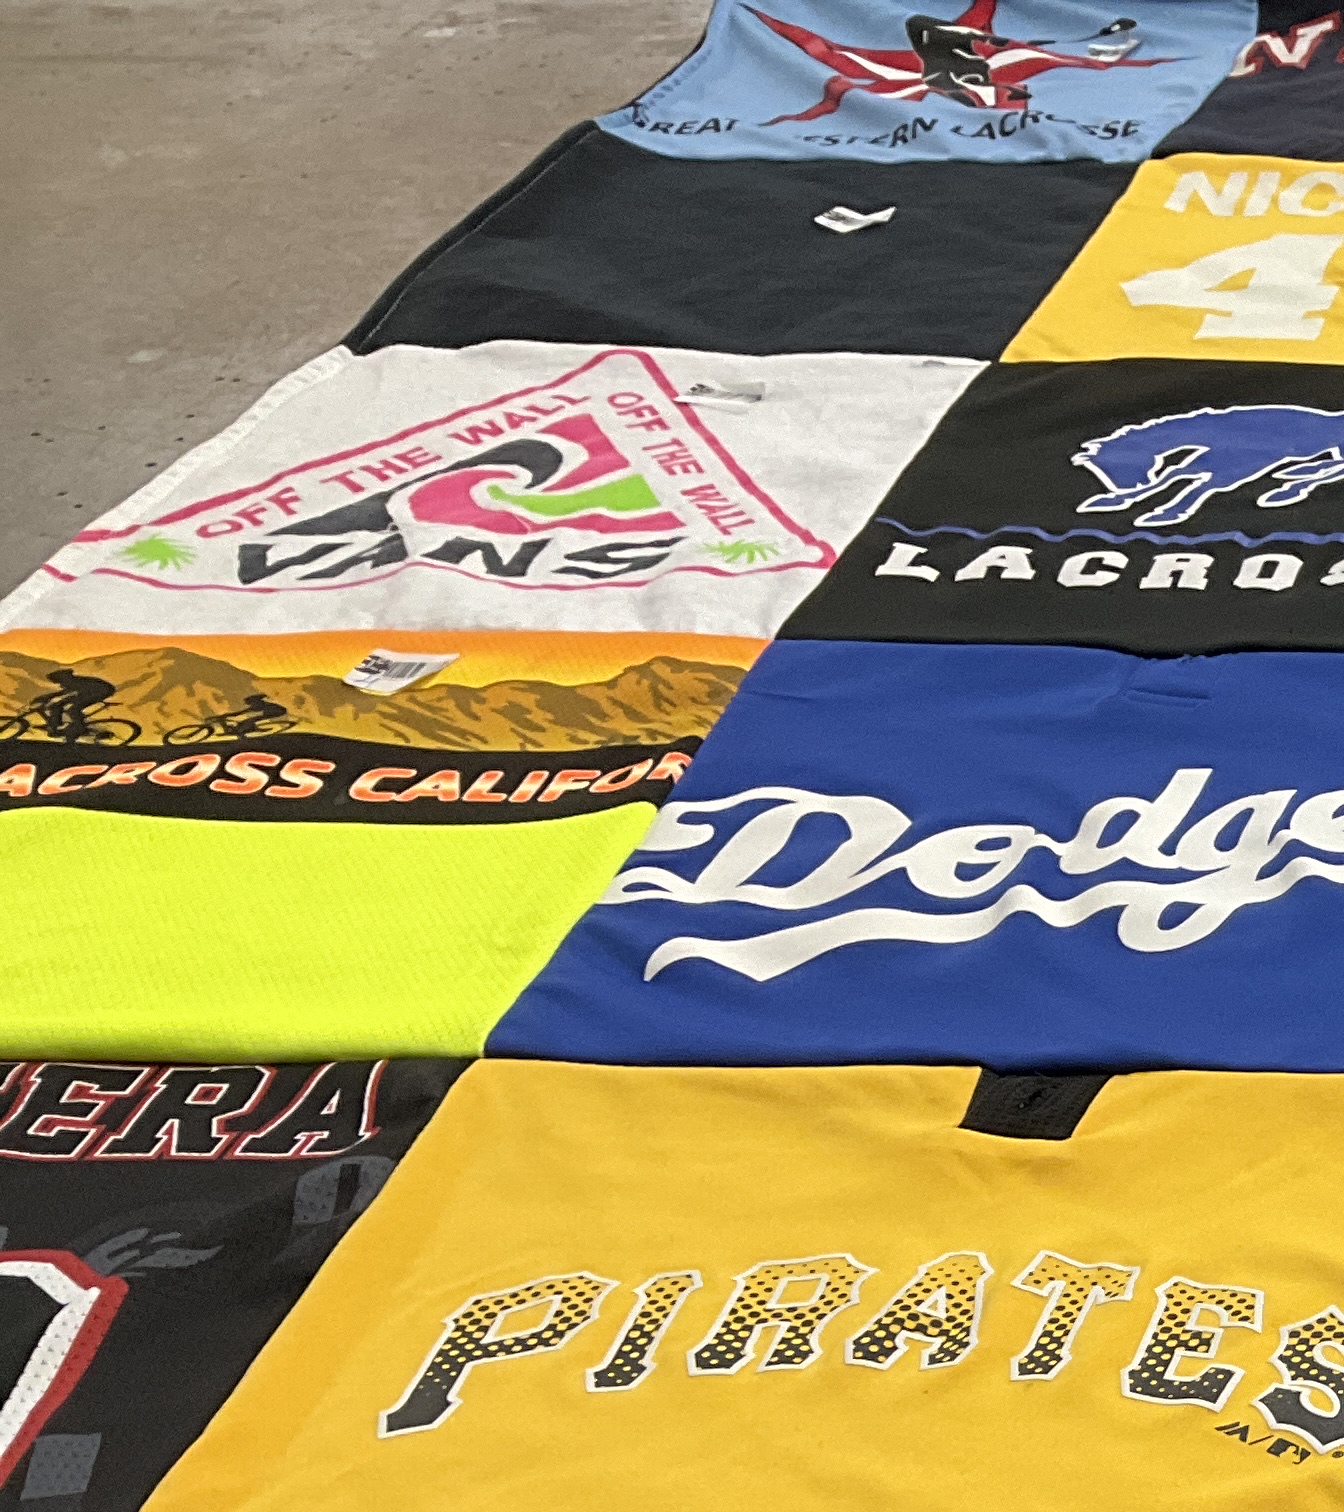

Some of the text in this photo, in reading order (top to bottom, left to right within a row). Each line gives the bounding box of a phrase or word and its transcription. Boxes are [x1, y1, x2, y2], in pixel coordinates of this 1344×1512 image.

[195, 394, 591, 538] OFF THE WALL
[607, 391, 755, 535] OFF THE WALL
[237, 531, 687, 585] VANS
[0, 751, 335, 799] ACROSS
[0, 1060, 386, 1163] ERA
